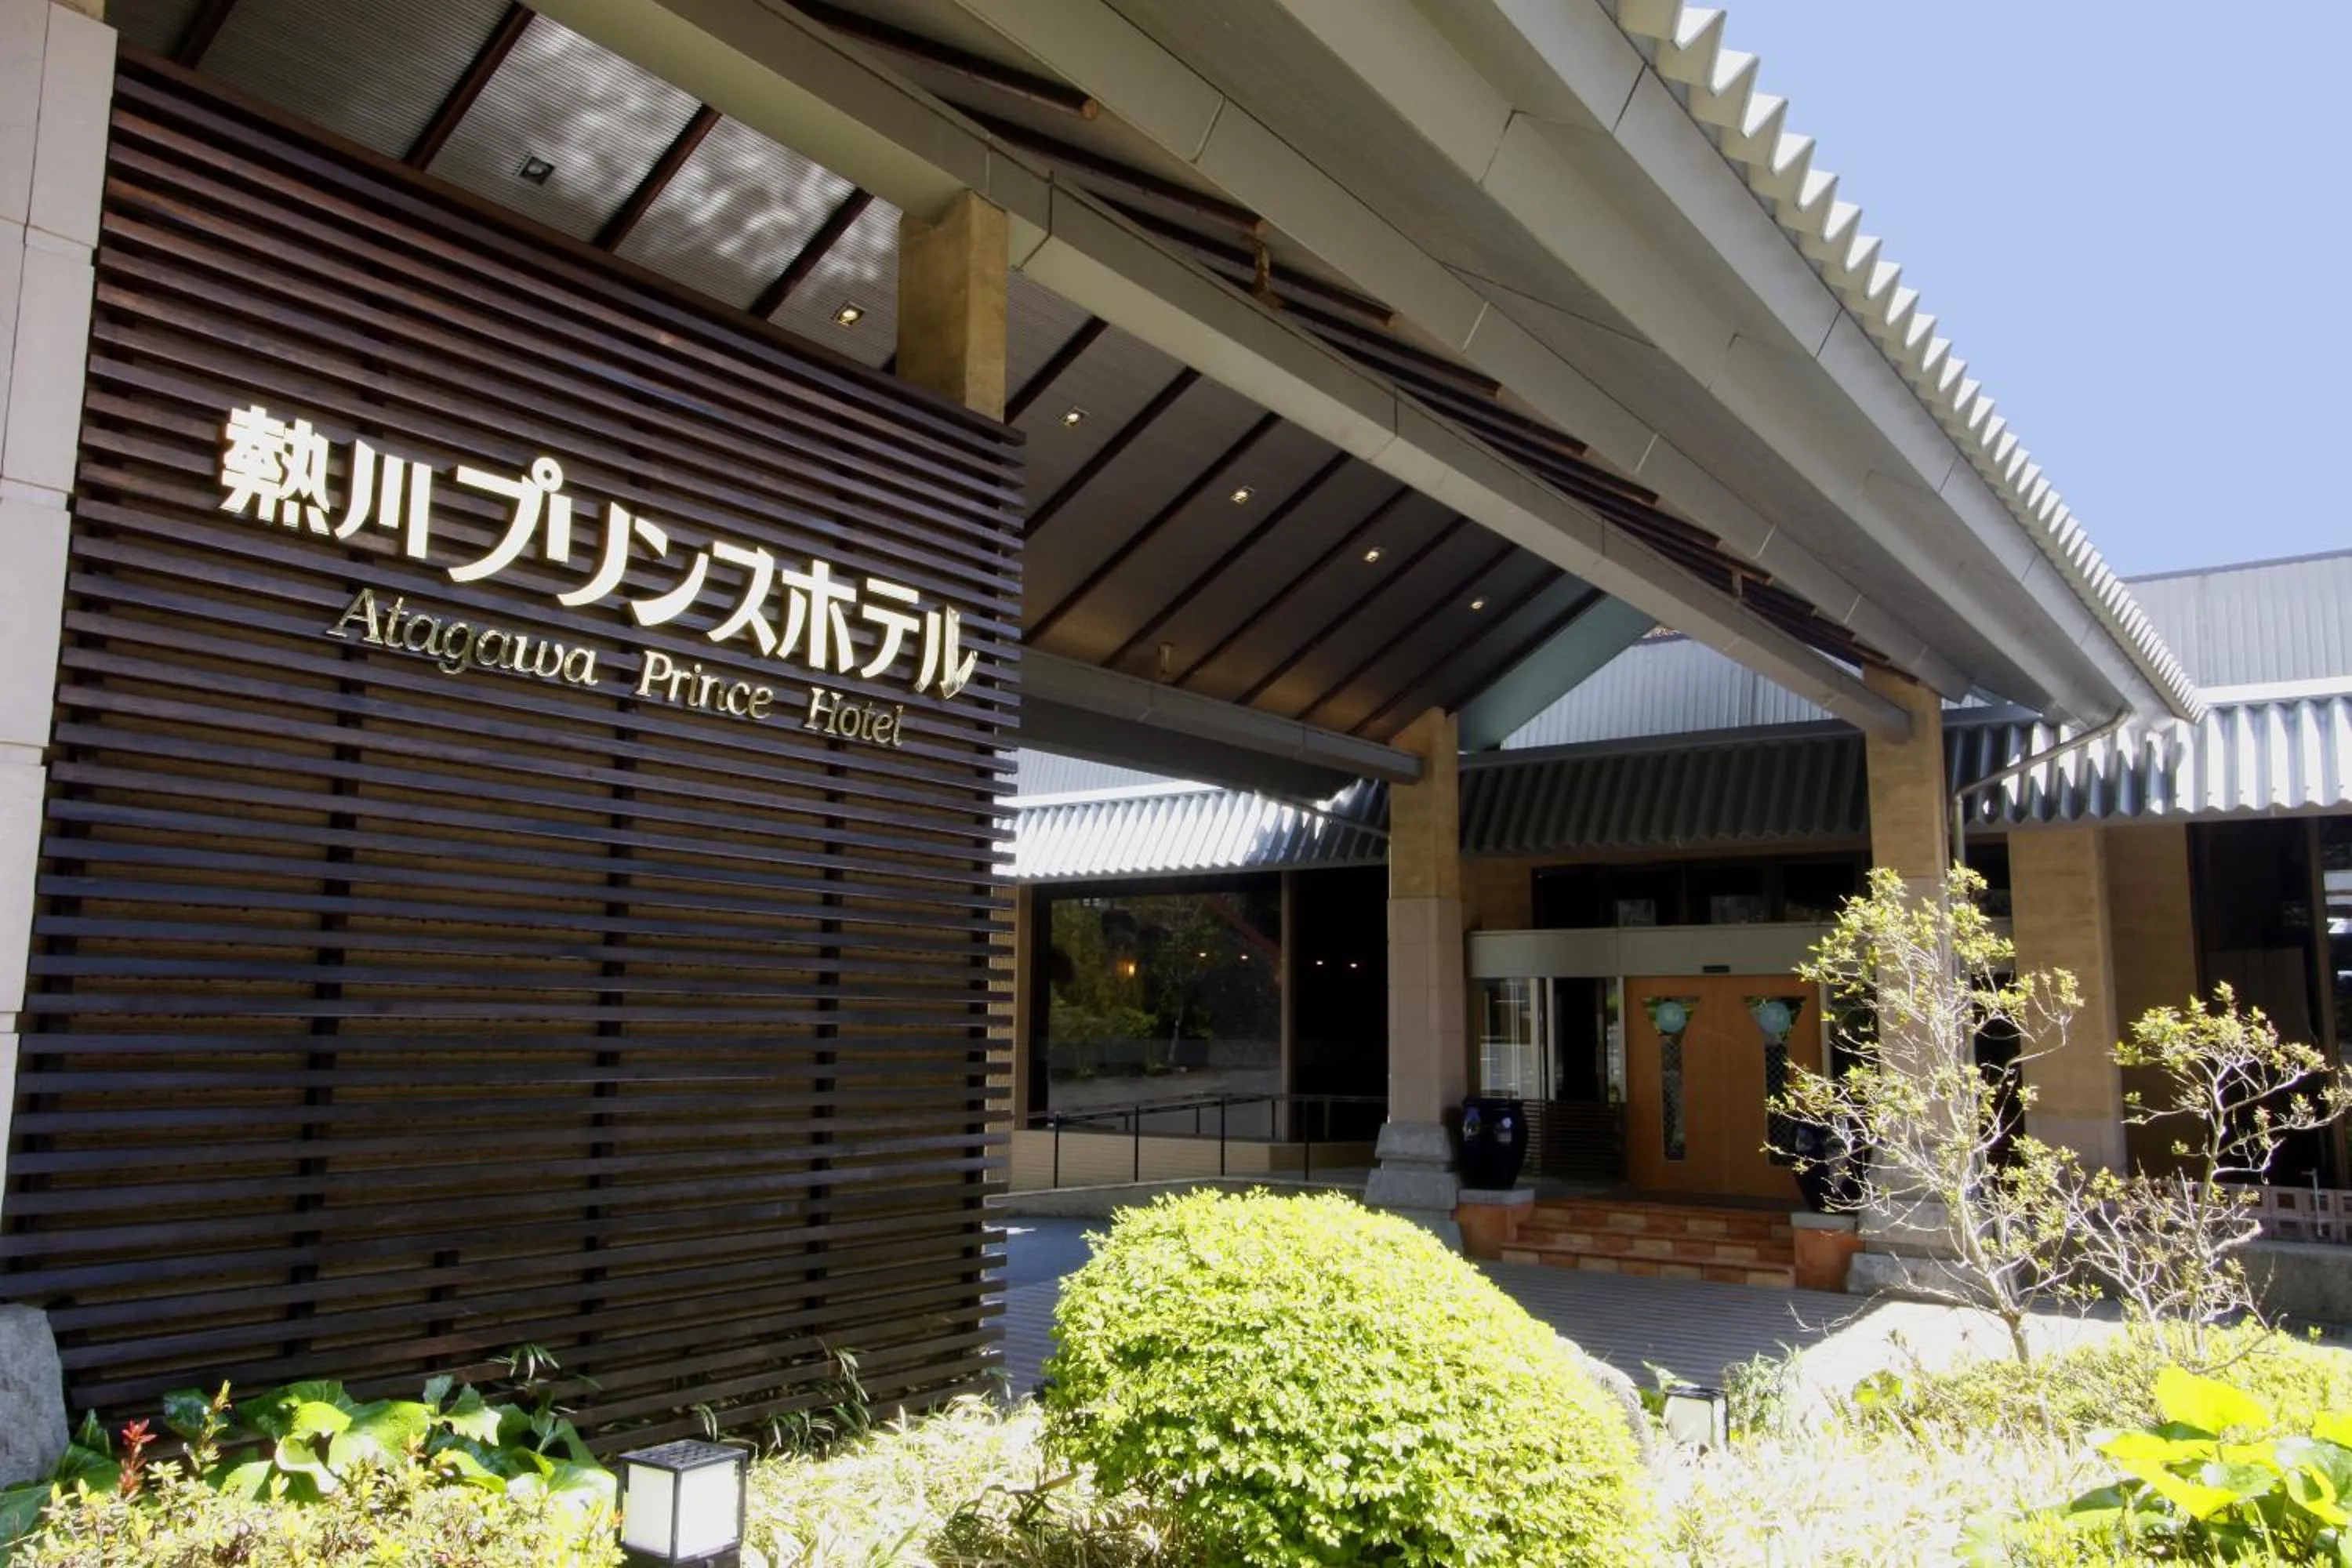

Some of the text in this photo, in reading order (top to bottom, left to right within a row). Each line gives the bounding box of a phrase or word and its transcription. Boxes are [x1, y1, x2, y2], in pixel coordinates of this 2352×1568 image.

[219, 405, 979, 700] 熱川プリンスホテル
[325, 586, 906, 748] Atagawa Prince Hotel
